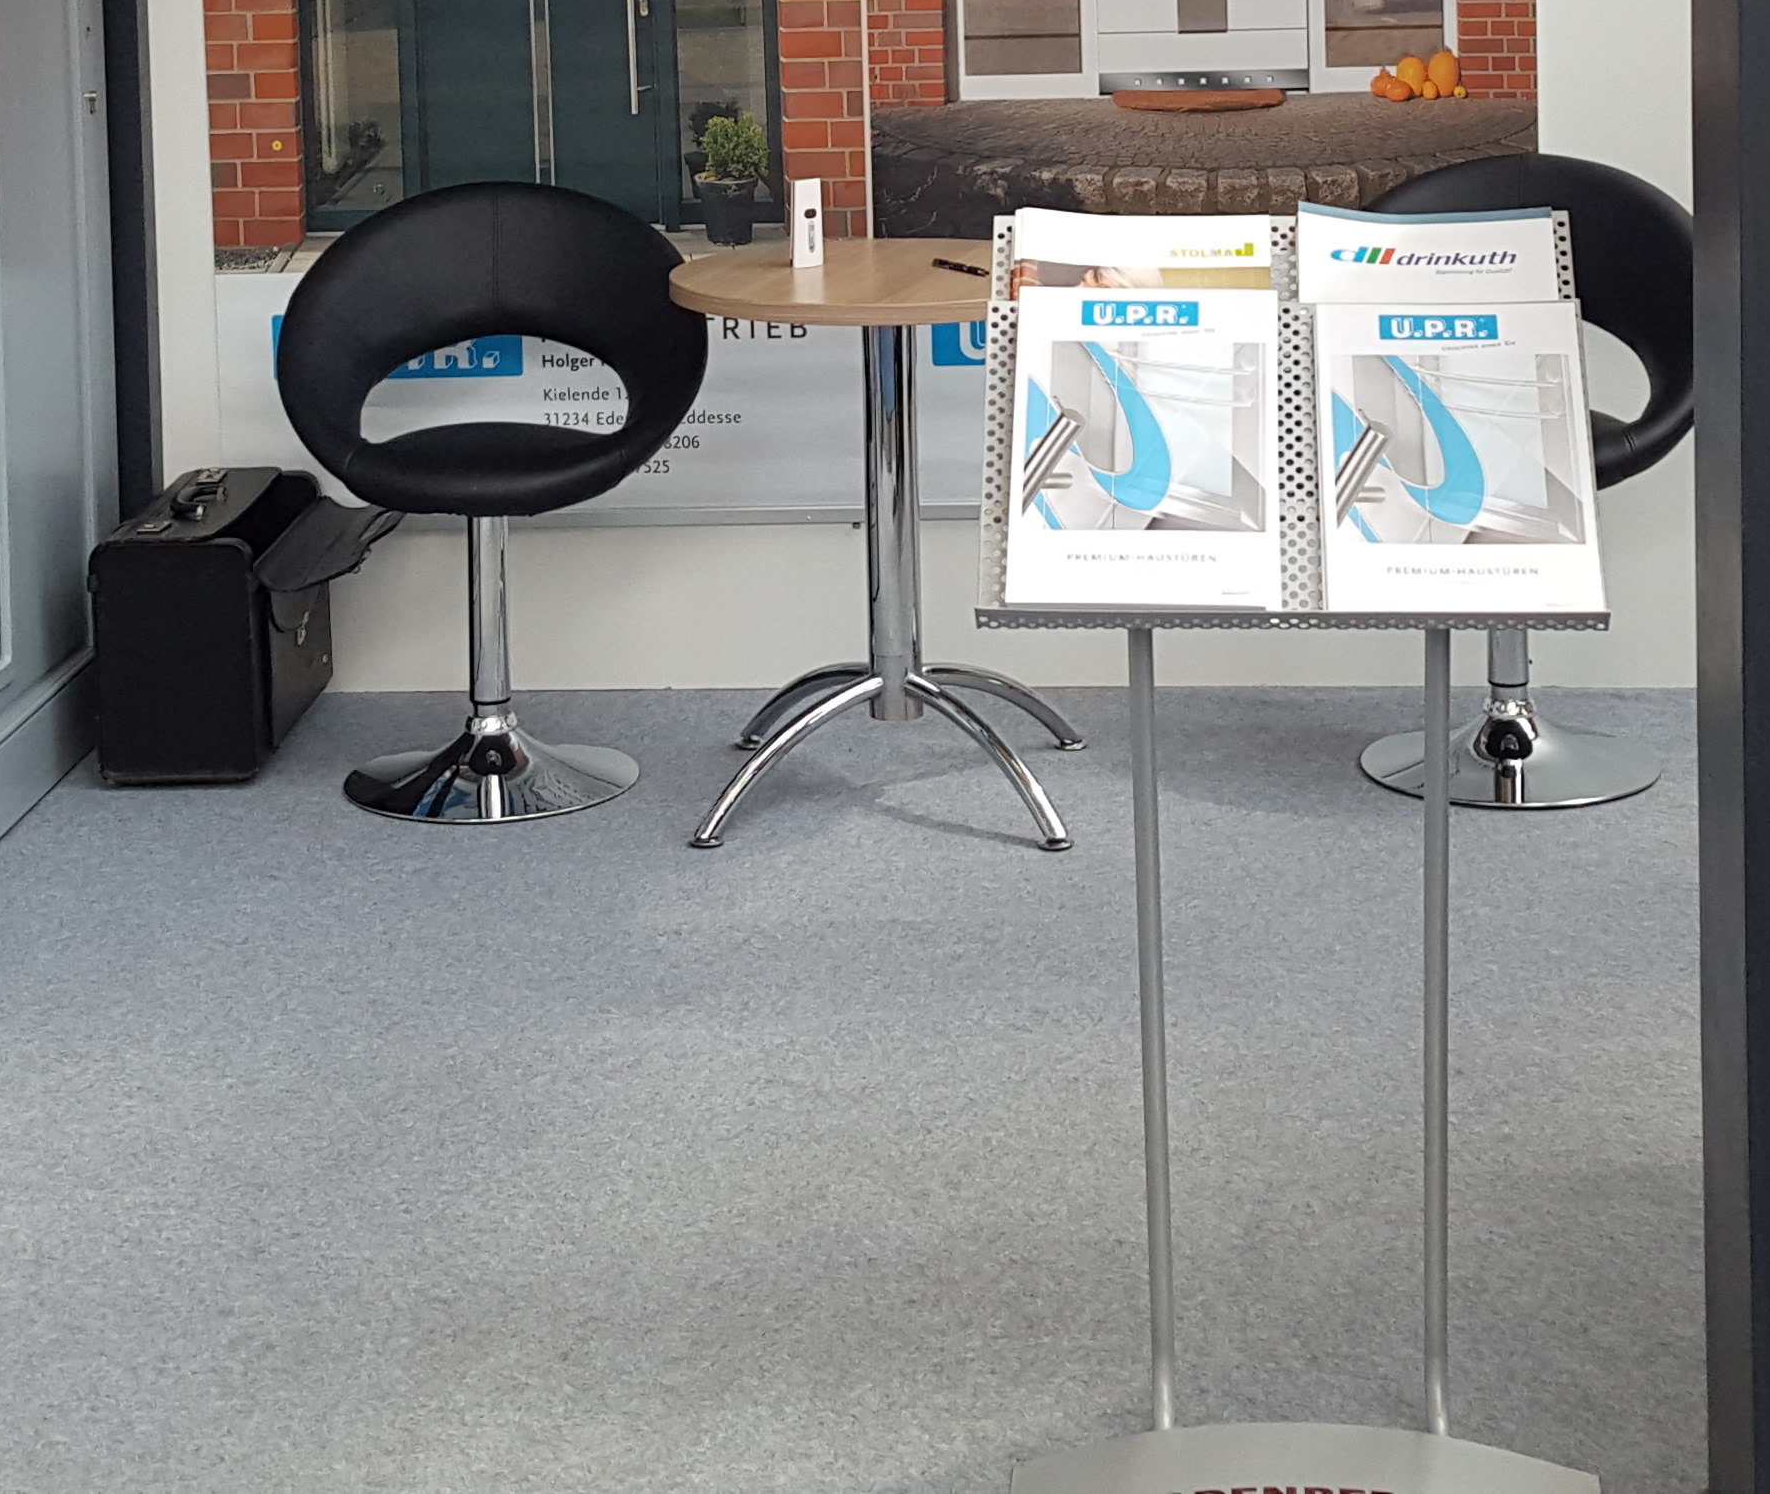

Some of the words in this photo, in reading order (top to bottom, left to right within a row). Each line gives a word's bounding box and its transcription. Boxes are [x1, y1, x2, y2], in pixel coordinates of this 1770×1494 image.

[1397, 251, 1517, 266] drinkuth
[542, 354, 594, 372] Holger
[543, 387, 609, 401] Kielende
[544, 412, 590, 426] 31234
